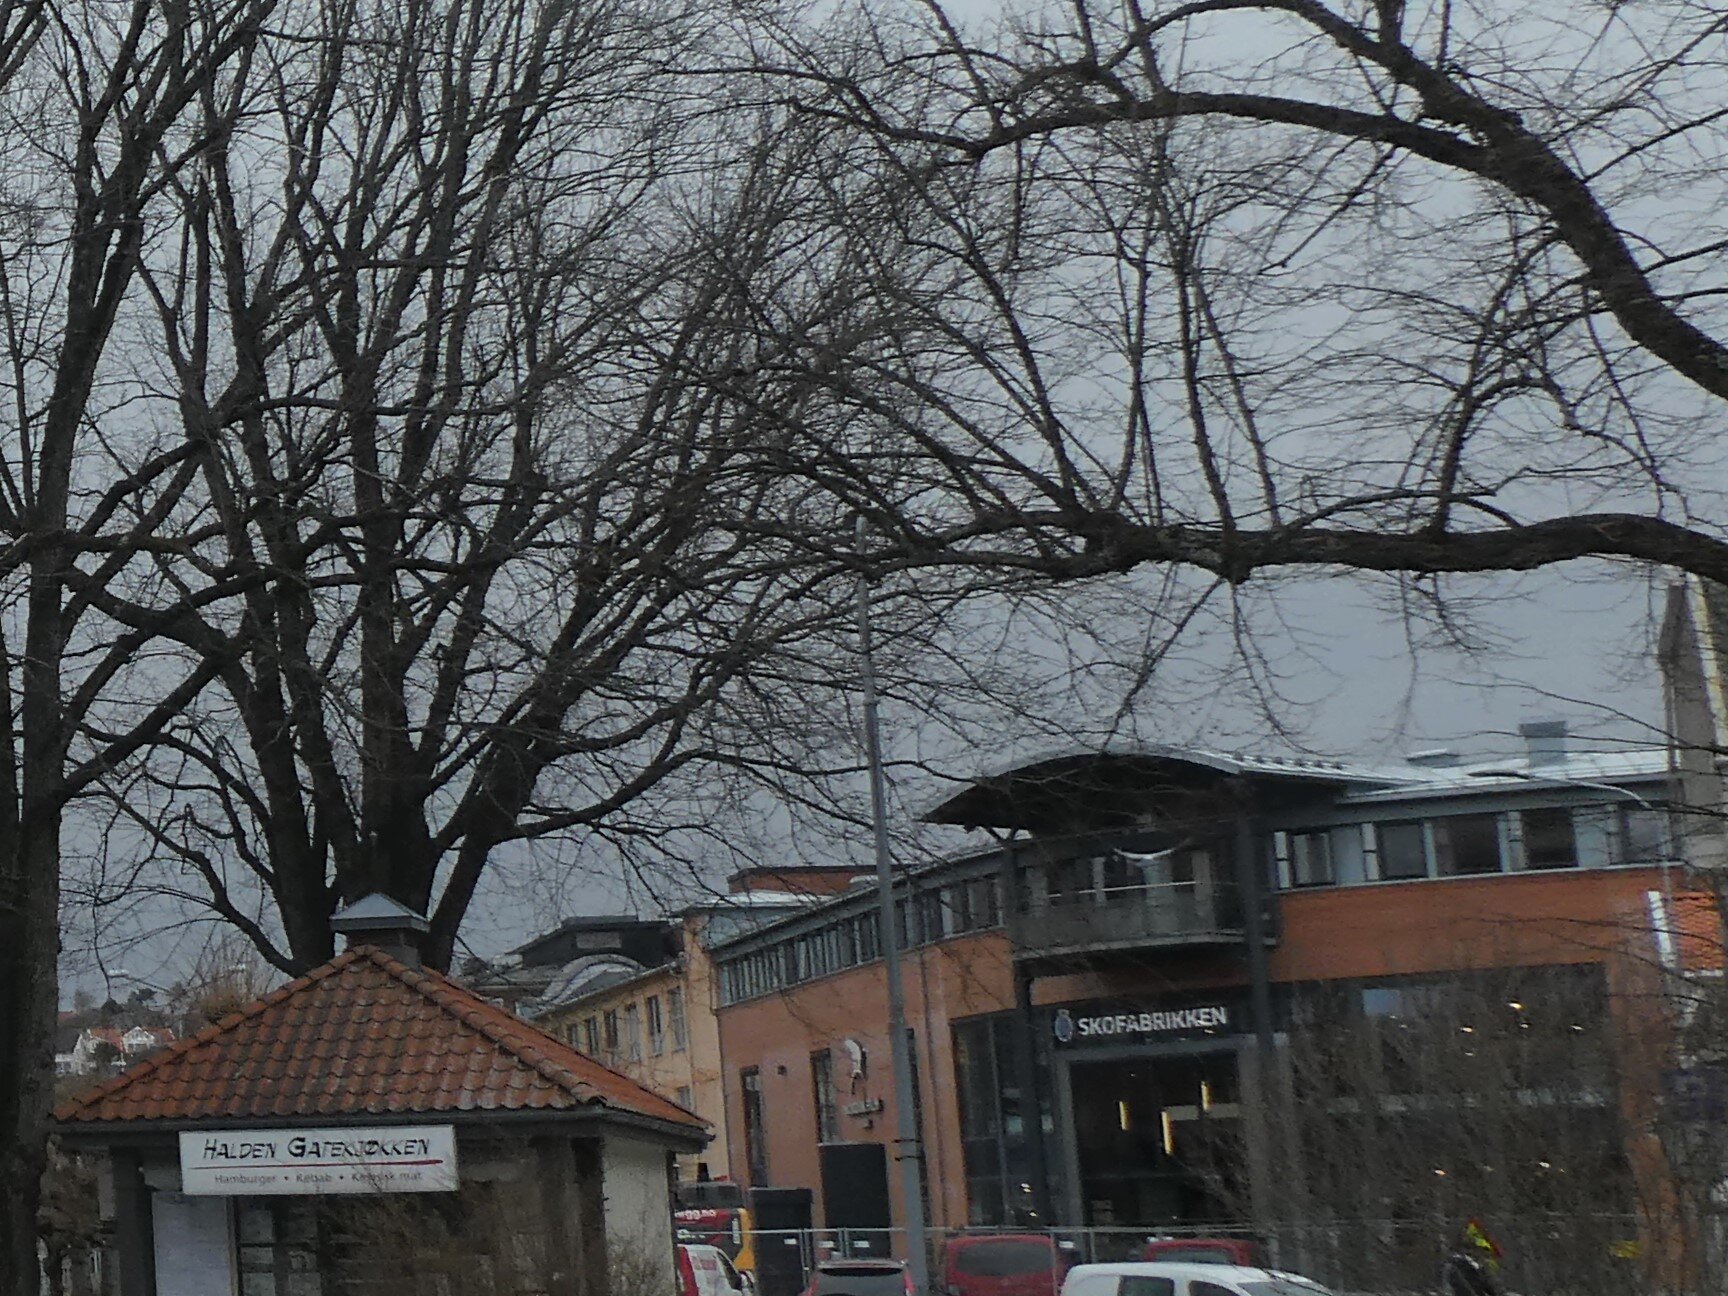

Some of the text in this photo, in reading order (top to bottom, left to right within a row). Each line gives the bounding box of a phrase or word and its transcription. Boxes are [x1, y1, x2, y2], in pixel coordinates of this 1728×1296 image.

[1077, 1006, 1228, 1036] SKOFABRIKKEN
[203, 1136, 432, 1160] HALDEN GATEKJØKKEN
[214, 1173, 277, 1186] Hamburger
